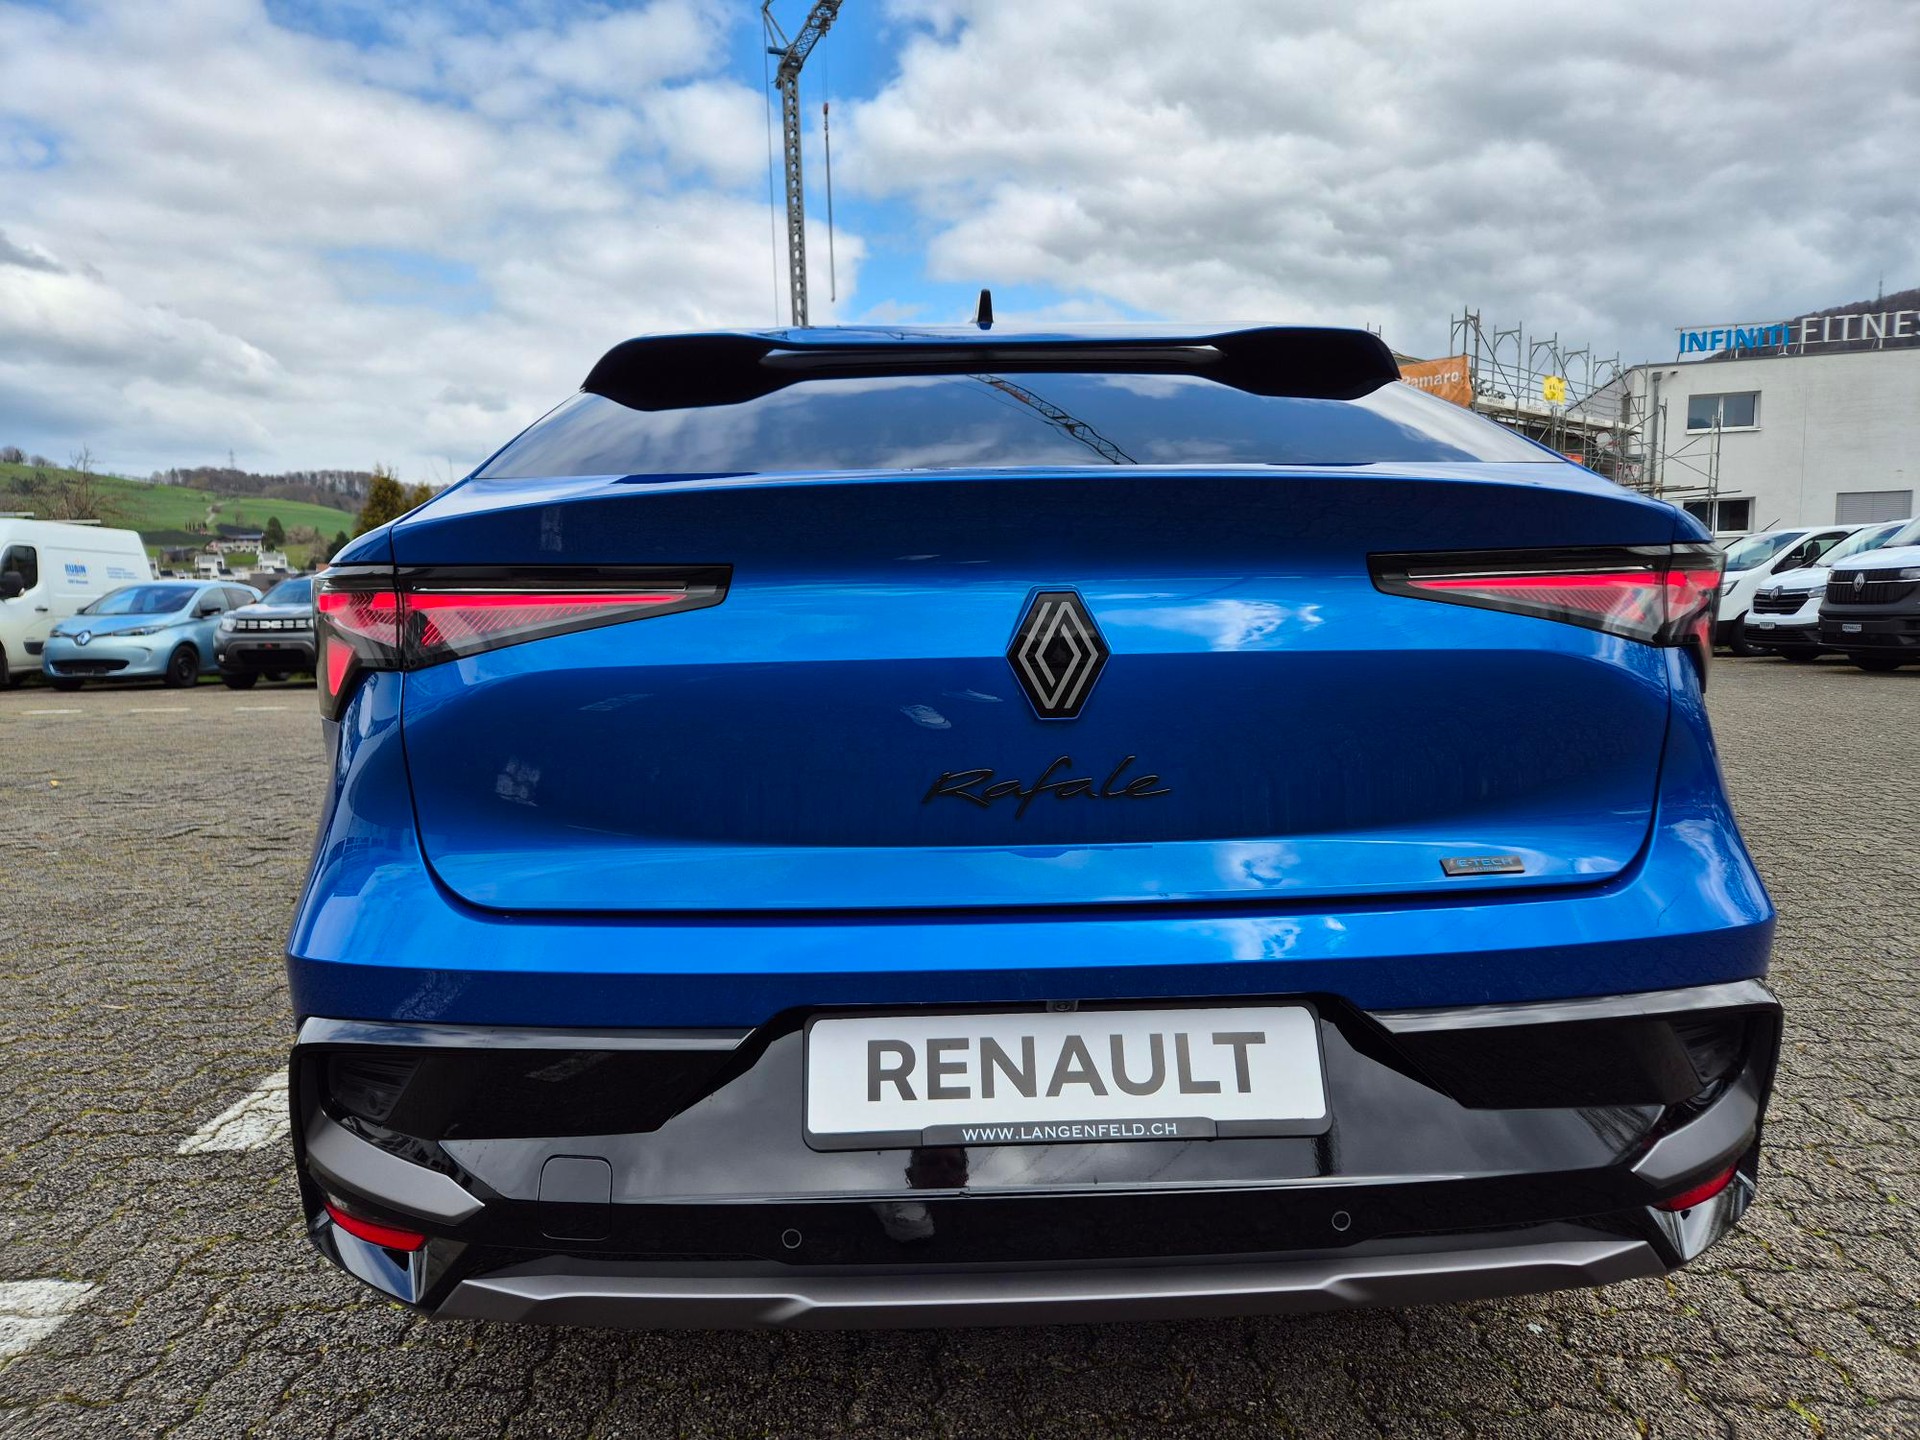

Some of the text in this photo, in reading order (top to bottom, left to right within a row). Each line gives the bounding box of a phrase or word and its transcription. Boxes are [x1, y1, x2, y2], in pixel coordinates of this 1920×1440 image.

[1680, 310, 1920, 353] INFINITI FITNE
[921, 755, 1171, 819] Rafale
[866, 1031, 1266, 1102] RENAULT
[962, 1123, 1177, 1141] WWW.LANGENFELD.CH
